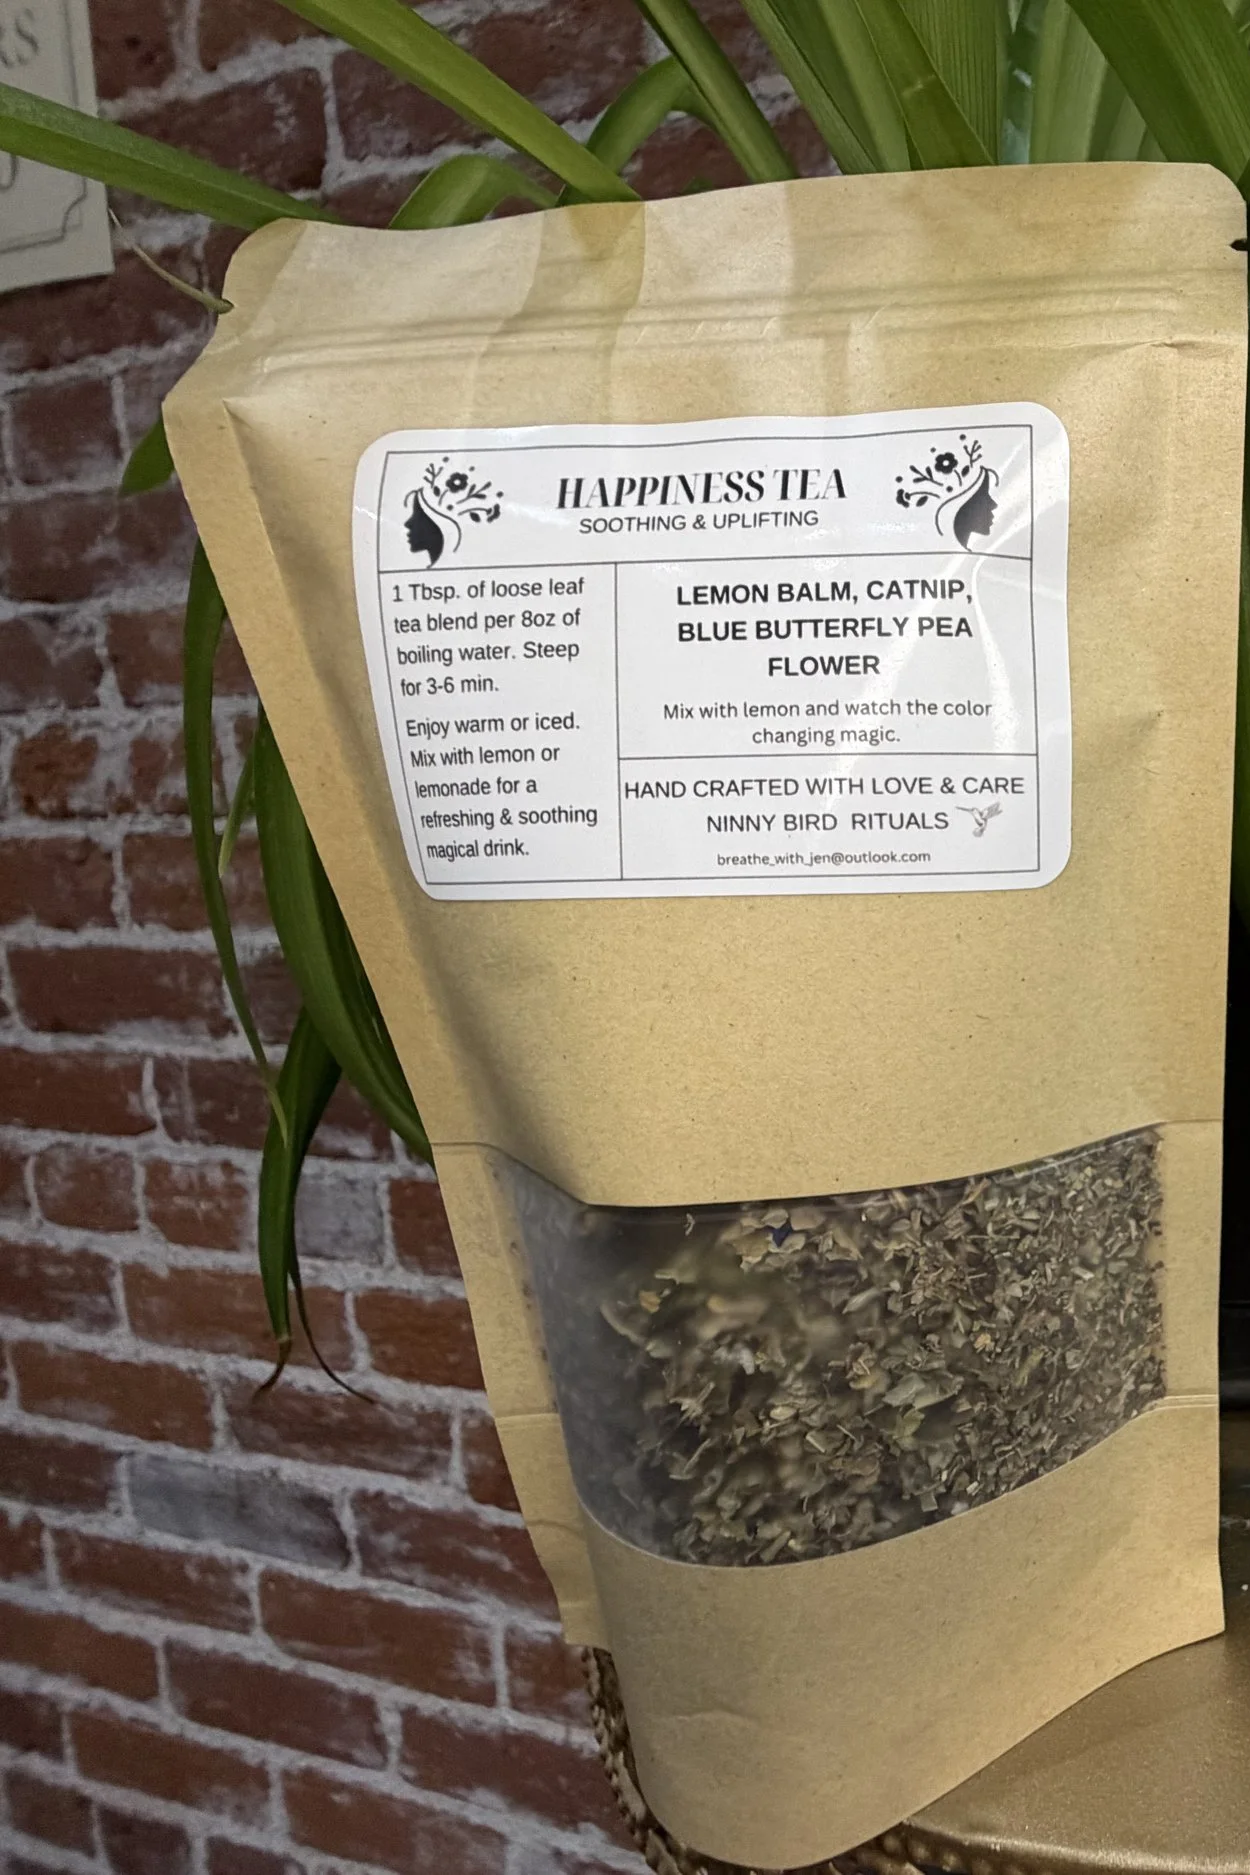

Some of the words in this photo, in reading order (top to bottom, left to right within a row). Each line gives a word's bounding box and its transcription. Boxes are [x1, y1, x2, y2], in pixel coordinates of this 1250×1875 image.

[558, 472, 764, 509] HAPPINESS
[773, 469, 847, 500] TEA
[579, 515, 686, 534] SOOTHING
[693, 515, 706, 530] &
[713, 510, 819, 529] UPLIFTING
[392, 584, 402, 602] 1
[409, 582, 461, 603] Tbsp.
[467, 581, 485, 598] of
[491, 580, 542, 597] loose
[549, 577, 585, 595] leaf
[677, 582, 768, 605] LEMON
[777, 582, 858, 604] BALM,
[867, 579, 972, 604] CATNIP,
[394, 617, 421, 633] tea
[427, 612, 478, 631] blend
[484, 613, 515, 632] per
[521, 610, 556, 627] 8oz
[562, 608, 580, 626] of
[678, 621, 747, 642] BLUE
[756, 618, 910, 640] BUTTERFLY
[918, 617, 973, 637] PEA
[397, 645, 453, 667] boiling
[459, 643, 516, 661] water.
[523, 641, 579, 662] Steep
[768, 655, 880, 676] FLOWER
[401, 677, 421, 696] for
[426, 676, 455, 695] 3-6
[461, 675, 499, 693] min.
[664, 704, 694, 720] Mix
[700, 701, 738, 718] with
[744, 701, 799, 717] lemon
[806, 700, 839, 716] and
[845, 699, 901, 716] watch
[907, 698, 938, 715] the
[944, 700, 992, 715] color
[406, 719, 449, 740] Enjoy
[455, 717, 504, 734] warm
[511, 715, 529, 731] or
[535, 712, 580, 730] iced.
[752, 728, 835, 747] changing
[840, 726, 901, 745] magic.
[411, 751, 437, 768] Mix
[441, 747, 474, 766] with
[479, 747, 535, 763] lemon
[542, 747, 560, 761] or
[415, 778, 491, 798] lemonade
[497, 777, 519, 794] for
[526, 778, 537, 793] a
[625, 780, 686, 799] HAND
[694, 778, 799, 797] CRAFTED
[806, 778, 864, 795] WITH
[872, 777, 932, 794] LOVE
[940, 778, 955, 794] &
[963, 777, 1024, 794] CARE
[421, 810, 495, 830] refreshing
[500, 809, 513, 824] &
[519, 806, 597, 827] soothing
[707, 814, 775, 832] NINNY
[784, 814, 837, 831] BIRD
[852, 812, 949, 830] RITUALS
[427, 840, 479, 862] magical
[484, 838, 529, 857] drink.
[717, 851, 931, 867] breathe_with_jen@outlook.com
